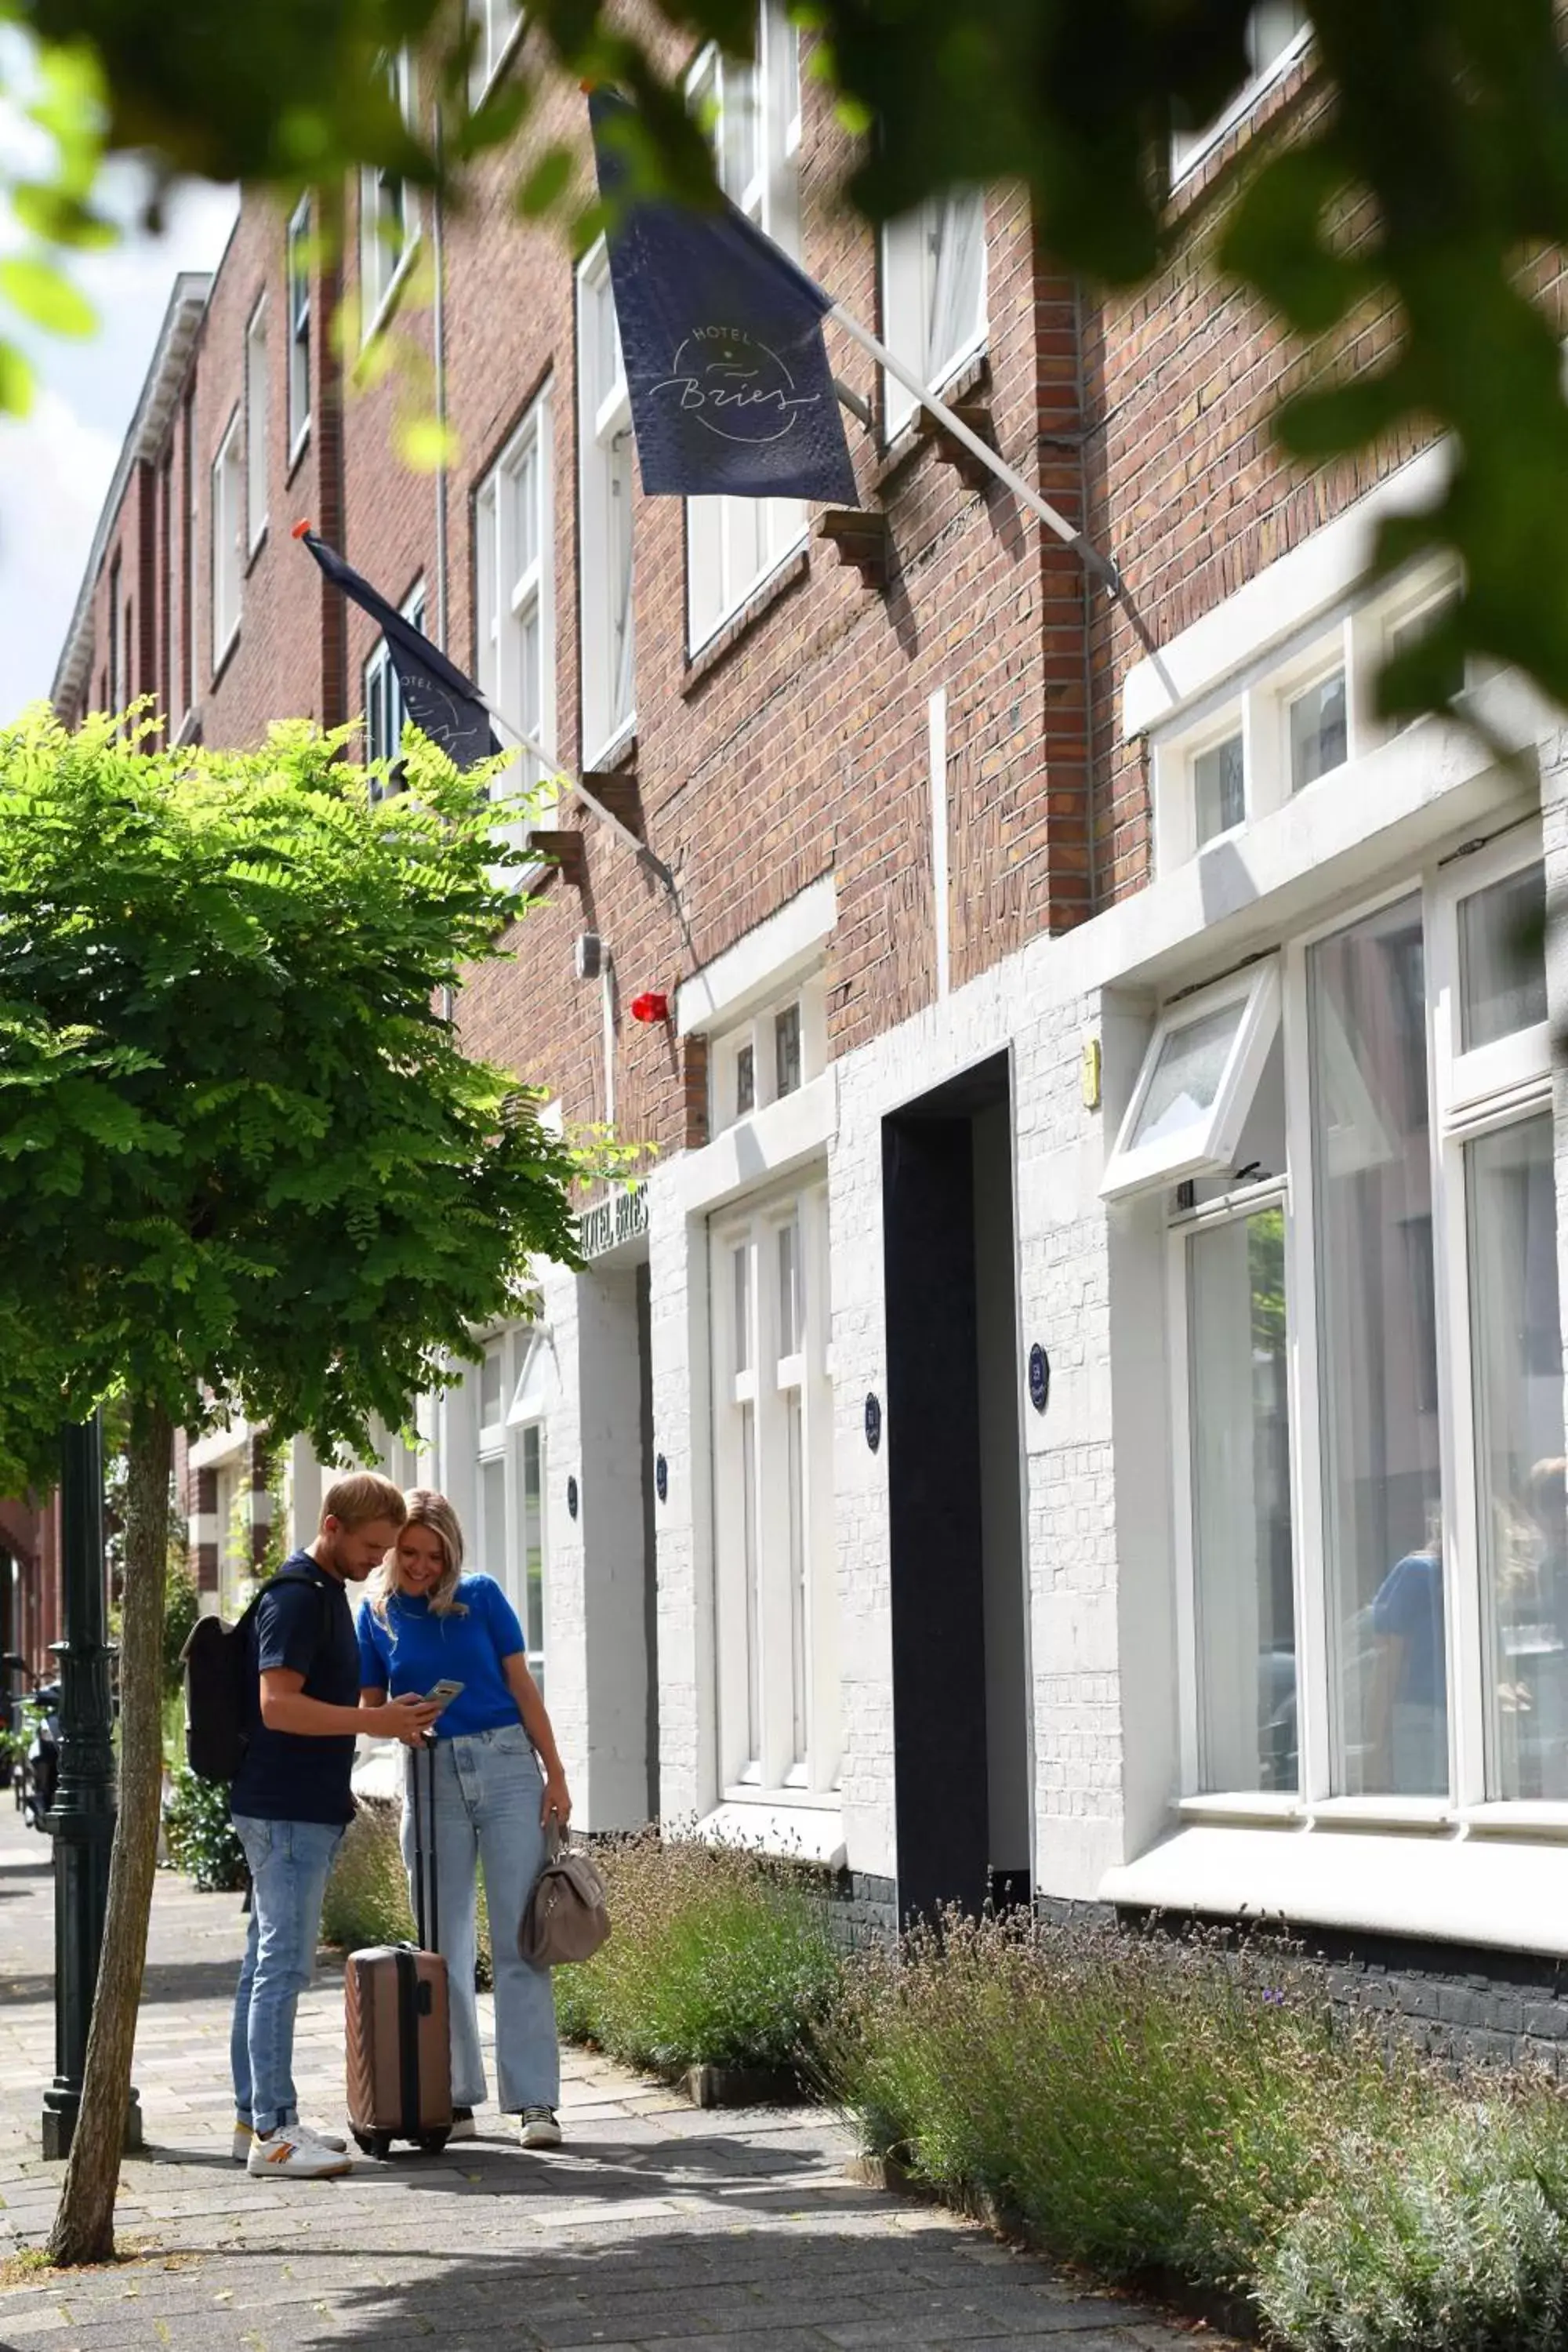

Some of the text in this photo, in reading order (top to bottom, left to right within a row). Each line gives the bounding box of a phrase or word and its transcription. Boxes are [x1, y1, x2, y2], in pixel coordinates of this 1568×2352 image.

[691, 325, 750, 345] HOTEL
[648, 378, 821, 409] Bries
[400, 675, 433, 691] OTEL
